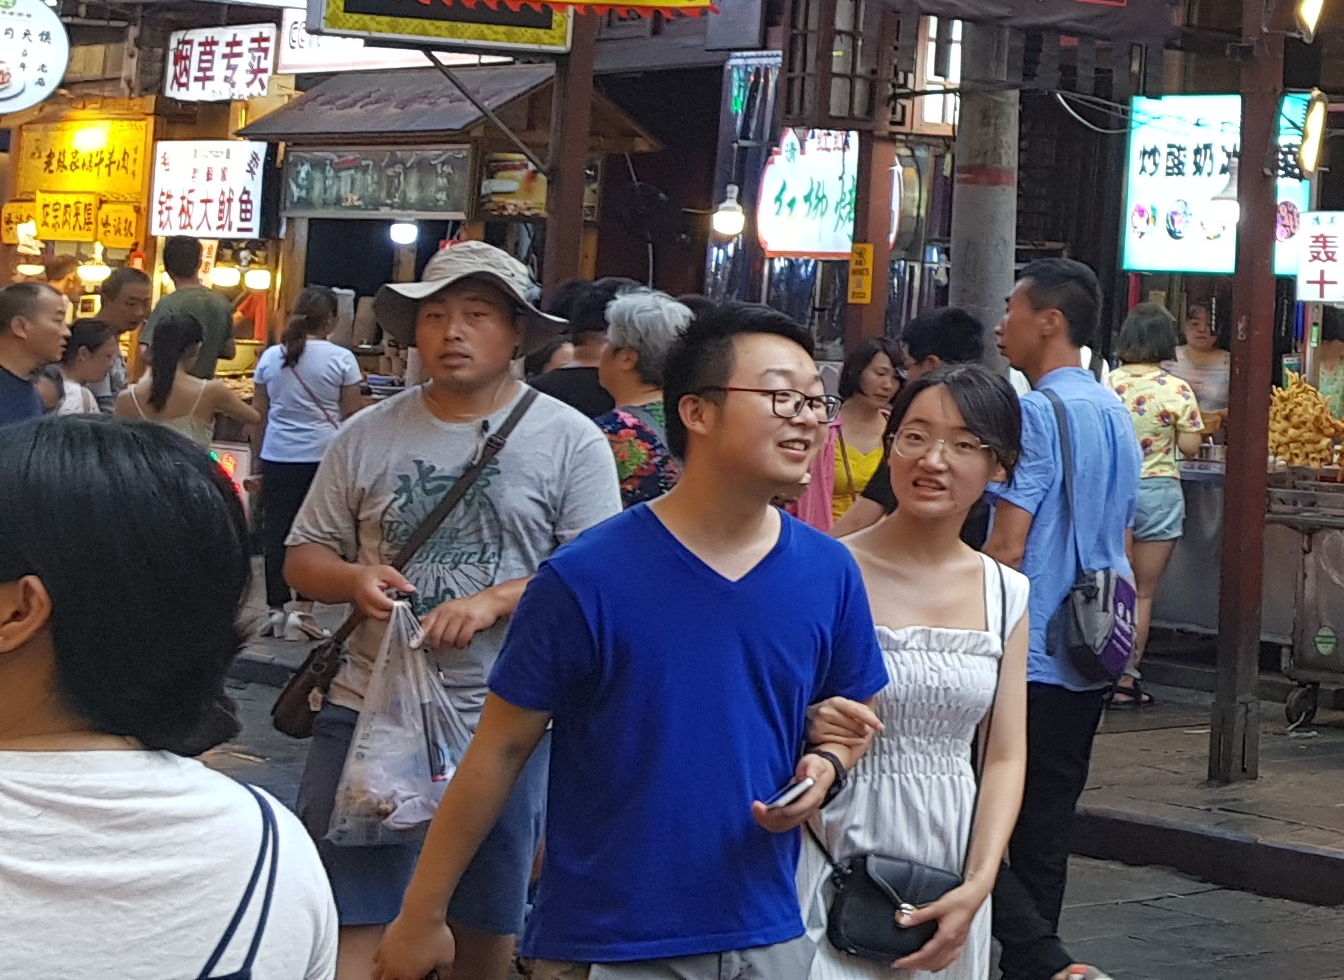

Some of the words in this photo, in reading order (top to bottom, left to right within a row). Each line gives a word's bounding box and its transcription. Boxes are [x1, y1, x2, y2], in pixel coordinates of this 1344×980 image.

[157, 184, 255, 234] 铁板大鱿鱼
